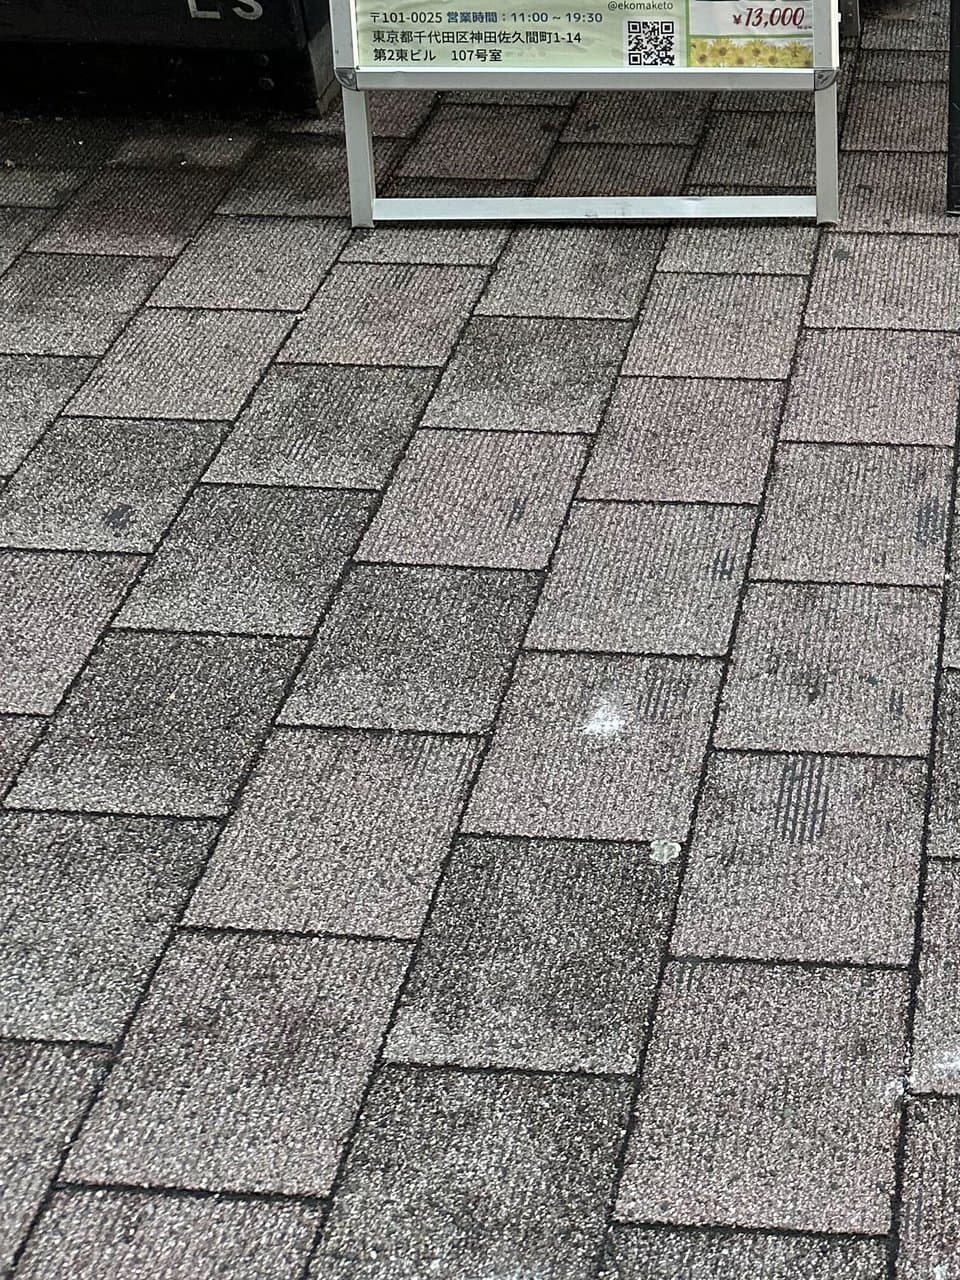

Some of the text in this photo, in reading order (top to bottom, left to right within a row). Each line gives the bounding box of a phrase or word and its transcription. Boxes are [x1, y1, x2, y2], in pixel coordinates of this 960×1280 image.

[607, 0, 674, 11] @ekomaketo
[372, 31, 582, 45] 東京都千代田区神田佐久間町1-14
[373, 48, 503, 63] 第2東ビル 107号室
